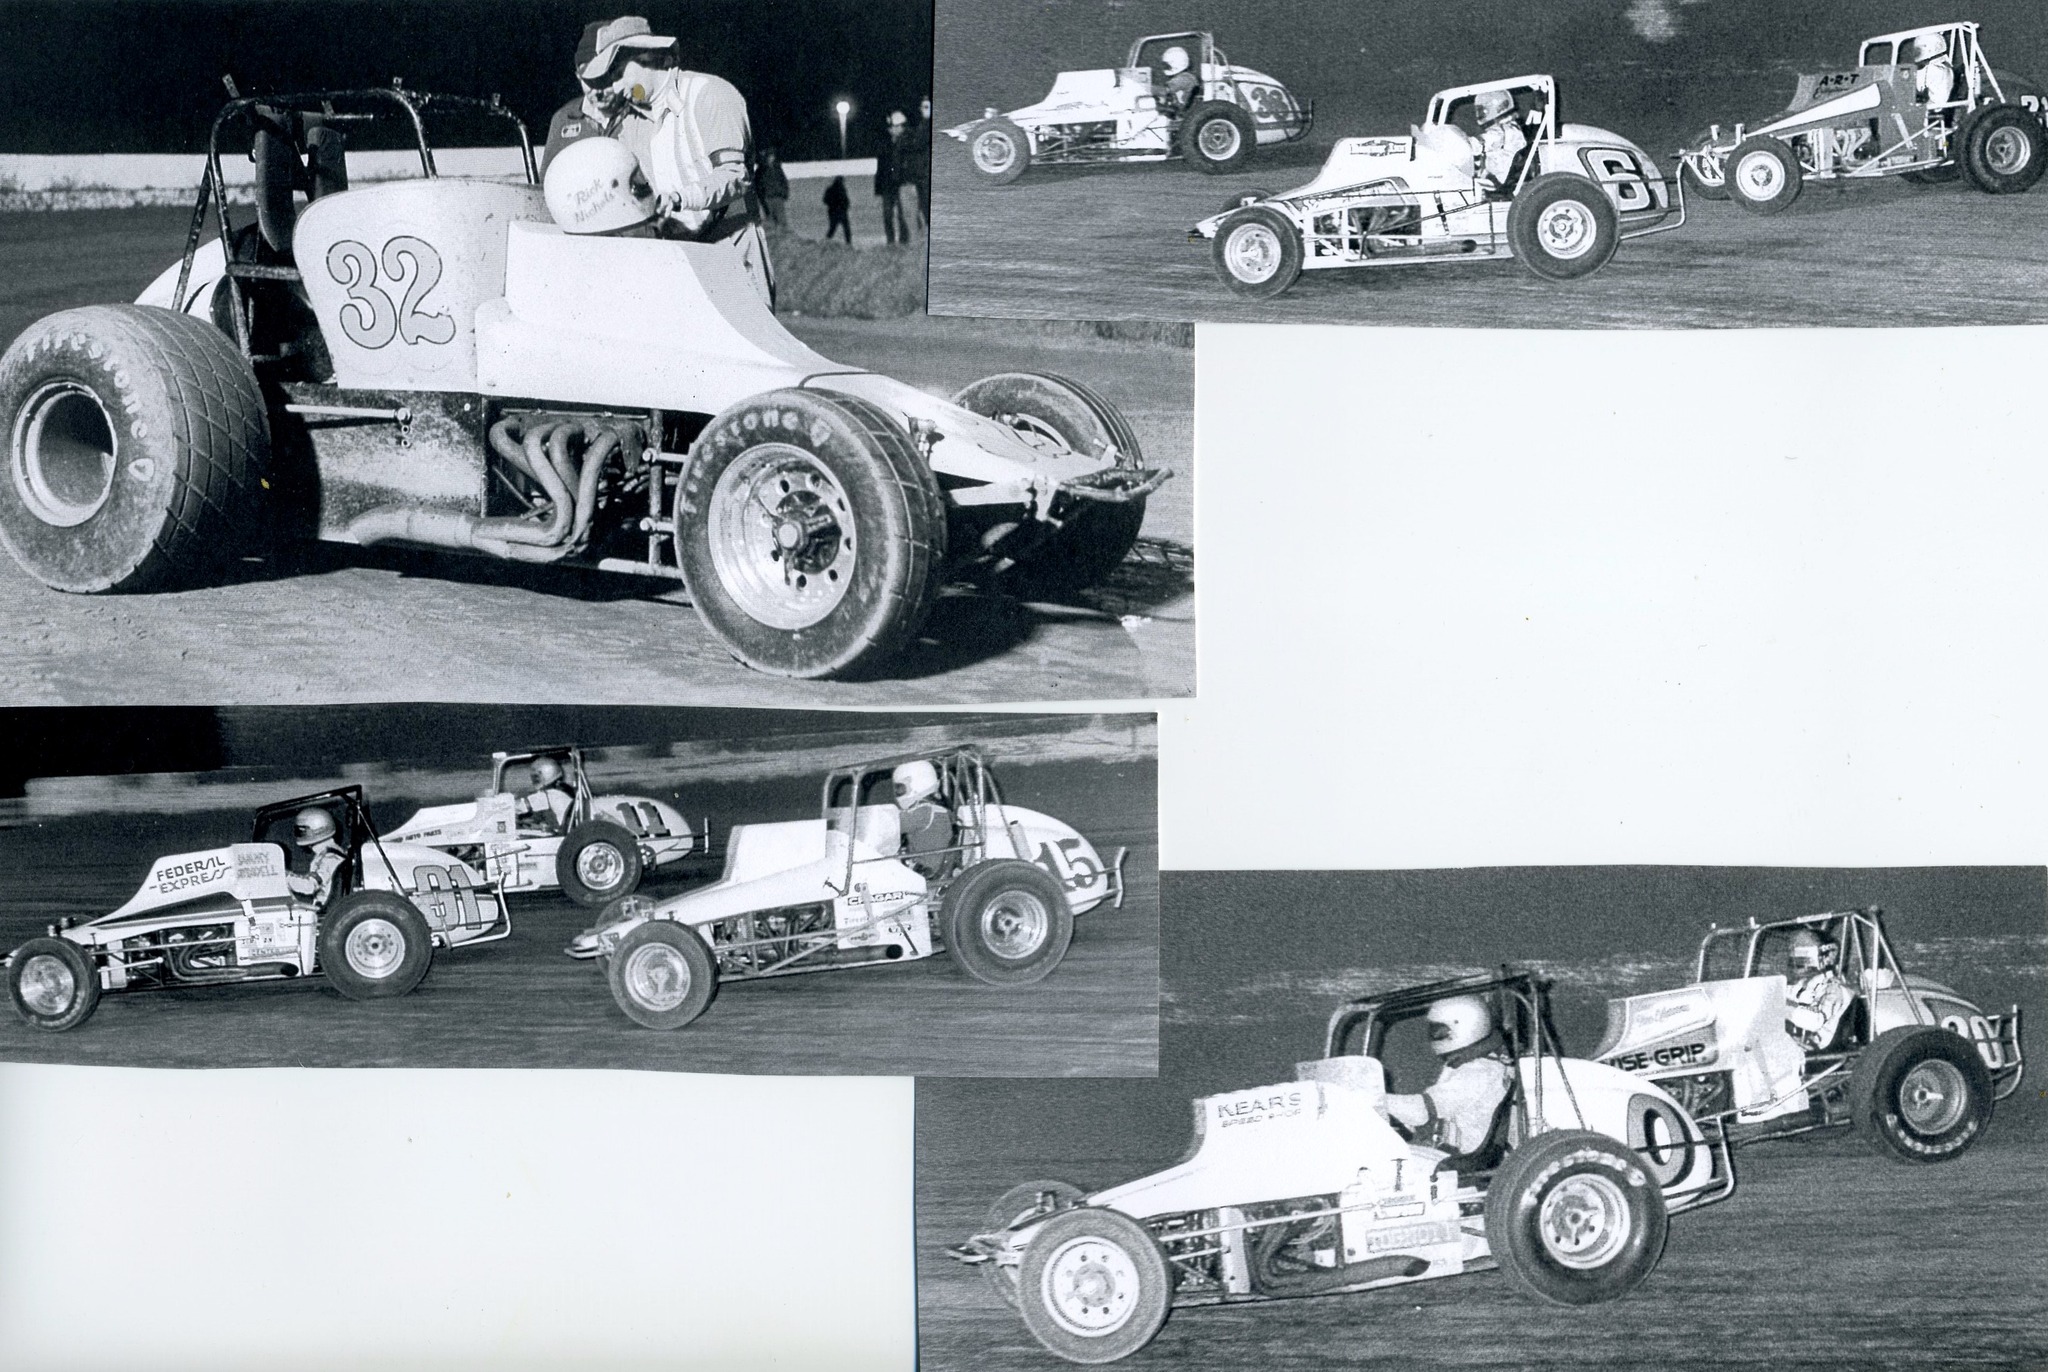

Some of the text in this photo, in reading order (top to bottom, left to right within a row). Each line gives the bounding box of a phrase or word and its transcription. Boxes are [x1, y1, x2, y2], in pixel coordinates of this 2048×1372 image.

[575, 178, 604, 205] Rick
[326, 235, 457, 350] 32
[615, 801, 671, 839] 11
[156, 856, 226, 882] FEDERAL
[1032, 838, 1098, 892] 15
[413, 864, 482, 932] 91
[1217, 1092, 1301, 1118] KEAR'S
[1221, 1115, 1263, 1128] SPEED
[1627, 1093, 1696, 1188] 0
